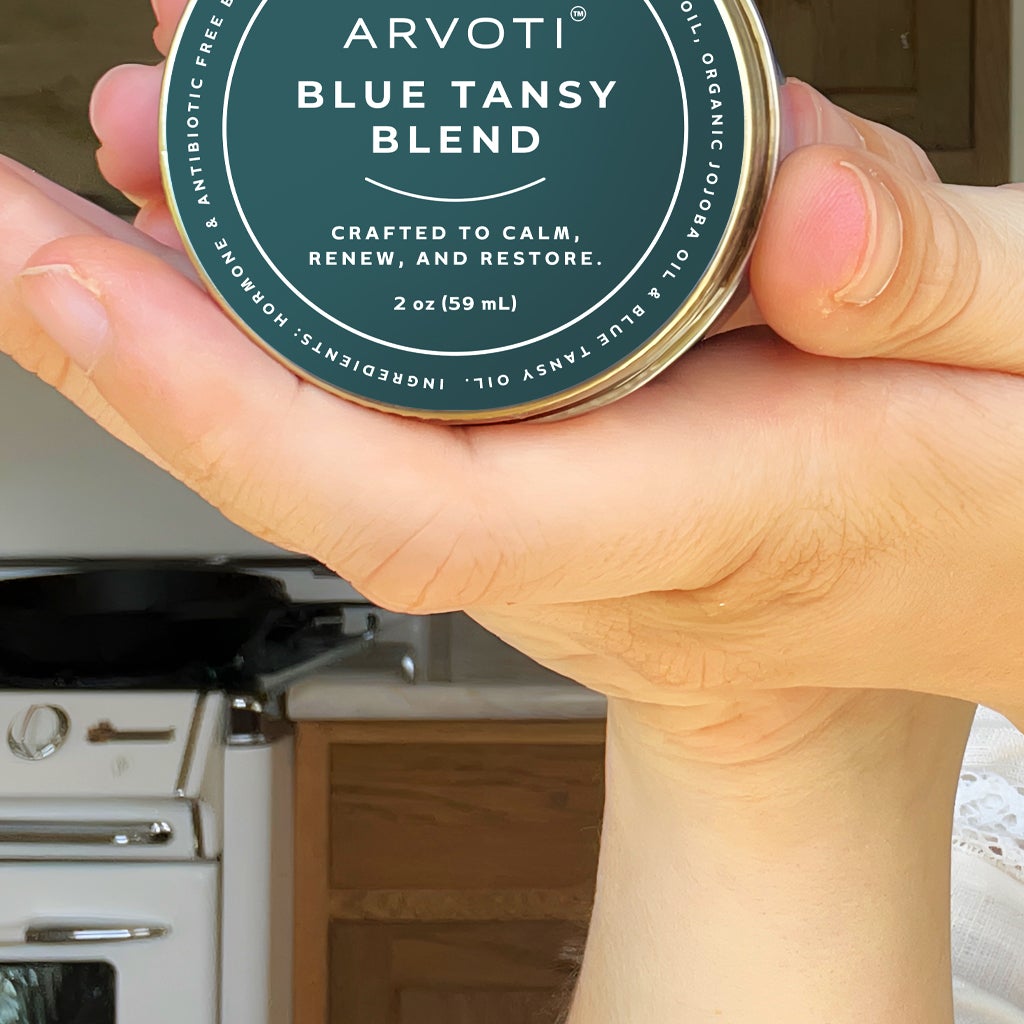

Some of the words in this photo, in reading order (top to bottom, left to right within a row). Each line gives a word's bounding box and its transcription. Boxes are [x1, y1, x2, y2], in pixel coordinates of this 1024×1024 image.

[342, 17, 562, 50] ARVOTI
[680, 0, 702, 43] OIL,
[195, 14, 224, 67] FREE
[297, 80, 425, 109] BLUE
[450, 80, 617, 109] TANSY
[701, 52, 724, 151] ORGANIC
[186, 77, 211, 205] ANTIBIOTIC
[372, 125, 540, 154] BLEND
[686, 161, 721, 238] JOJOBA
[205, 216, 218, 228] &
[331, 225, 447, 241] CRAFTED
[458, 225, 490, 241] TO
[502, 225, 580, 244] CALM,
[309, 251, 404, 269] RENEW,
[416, 251, 468, 266] AND
[480, 251, 603, 266] RESTORE.
[662, 249, 689, 278] OIL
[214, 237, 289, 328] HORMONE
[647, 287, 661, 299] &
[393, 296, 406, 311] 2
[412, 299, 435, 311] oz
[441, 294, 475, 313] (59
[481, 294, 518, 313] mL)
[596, 304, 646, 347] BLUE
[293, 328, 444, 390] INGREDIENTS:
[523, 345, 591, 382] TANSY
[464, 374, 510, 389] OIL.
